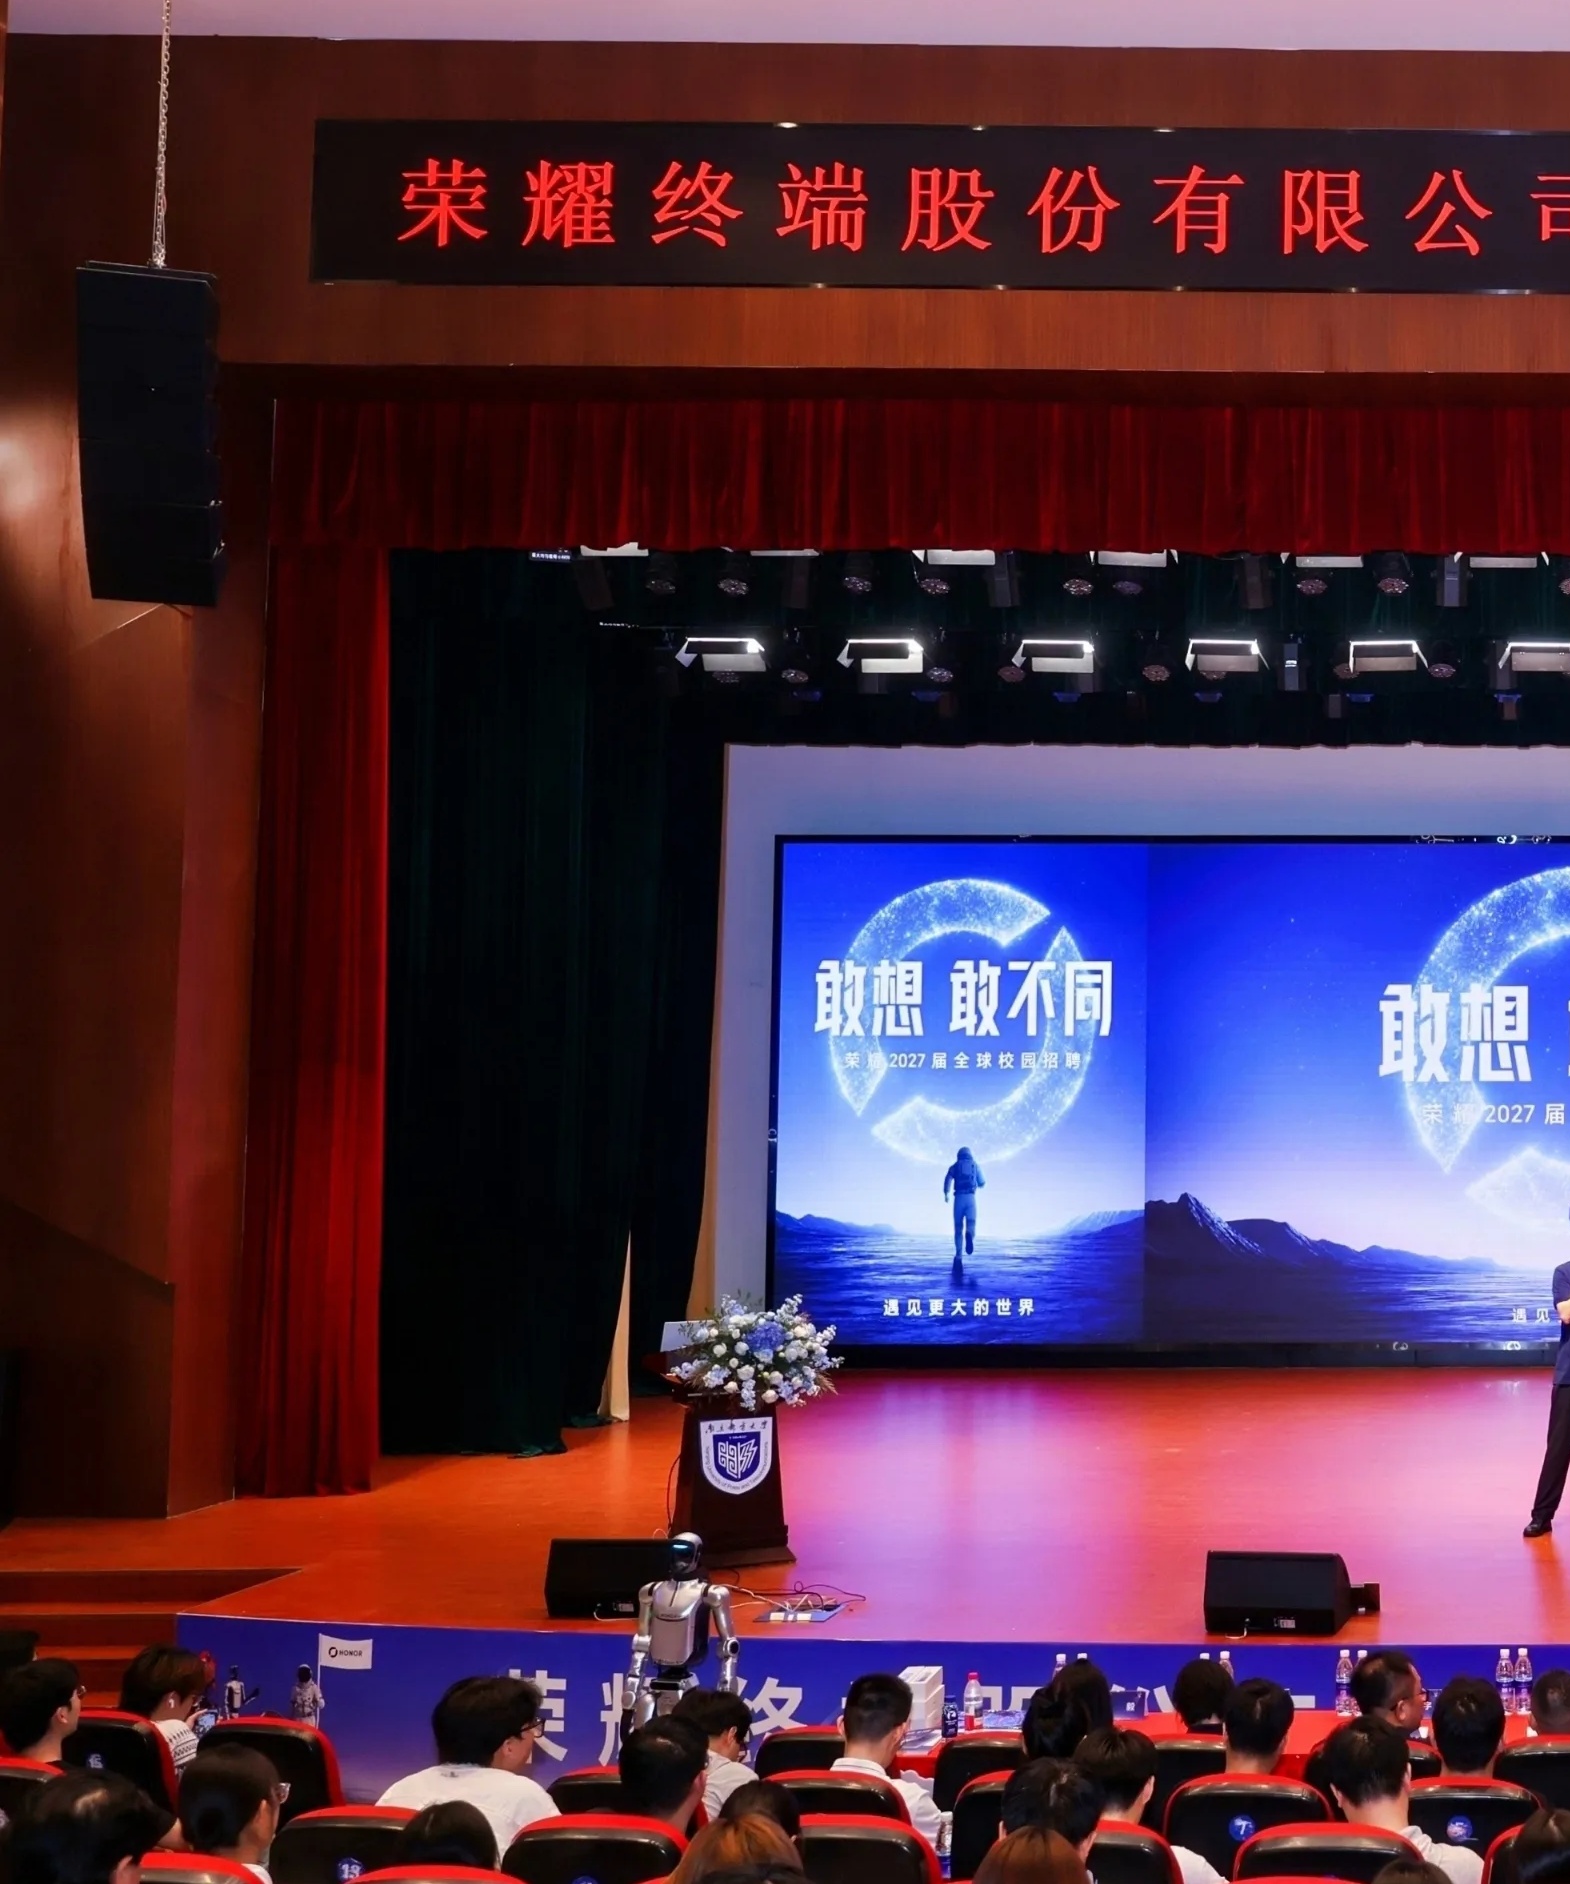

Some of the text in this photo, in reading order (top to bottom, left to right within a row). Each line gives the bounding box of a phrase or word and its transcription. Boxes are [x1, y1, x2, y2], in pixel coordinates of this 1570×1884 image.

[814, 959, 1113, 1036] 敢想 敢不同
[1378, 983, 1531, 1082] 敢想
[883, 1298, 1034, 1316] 遇见更大的世界
[339, 1649, 363, 1657] HONOR
